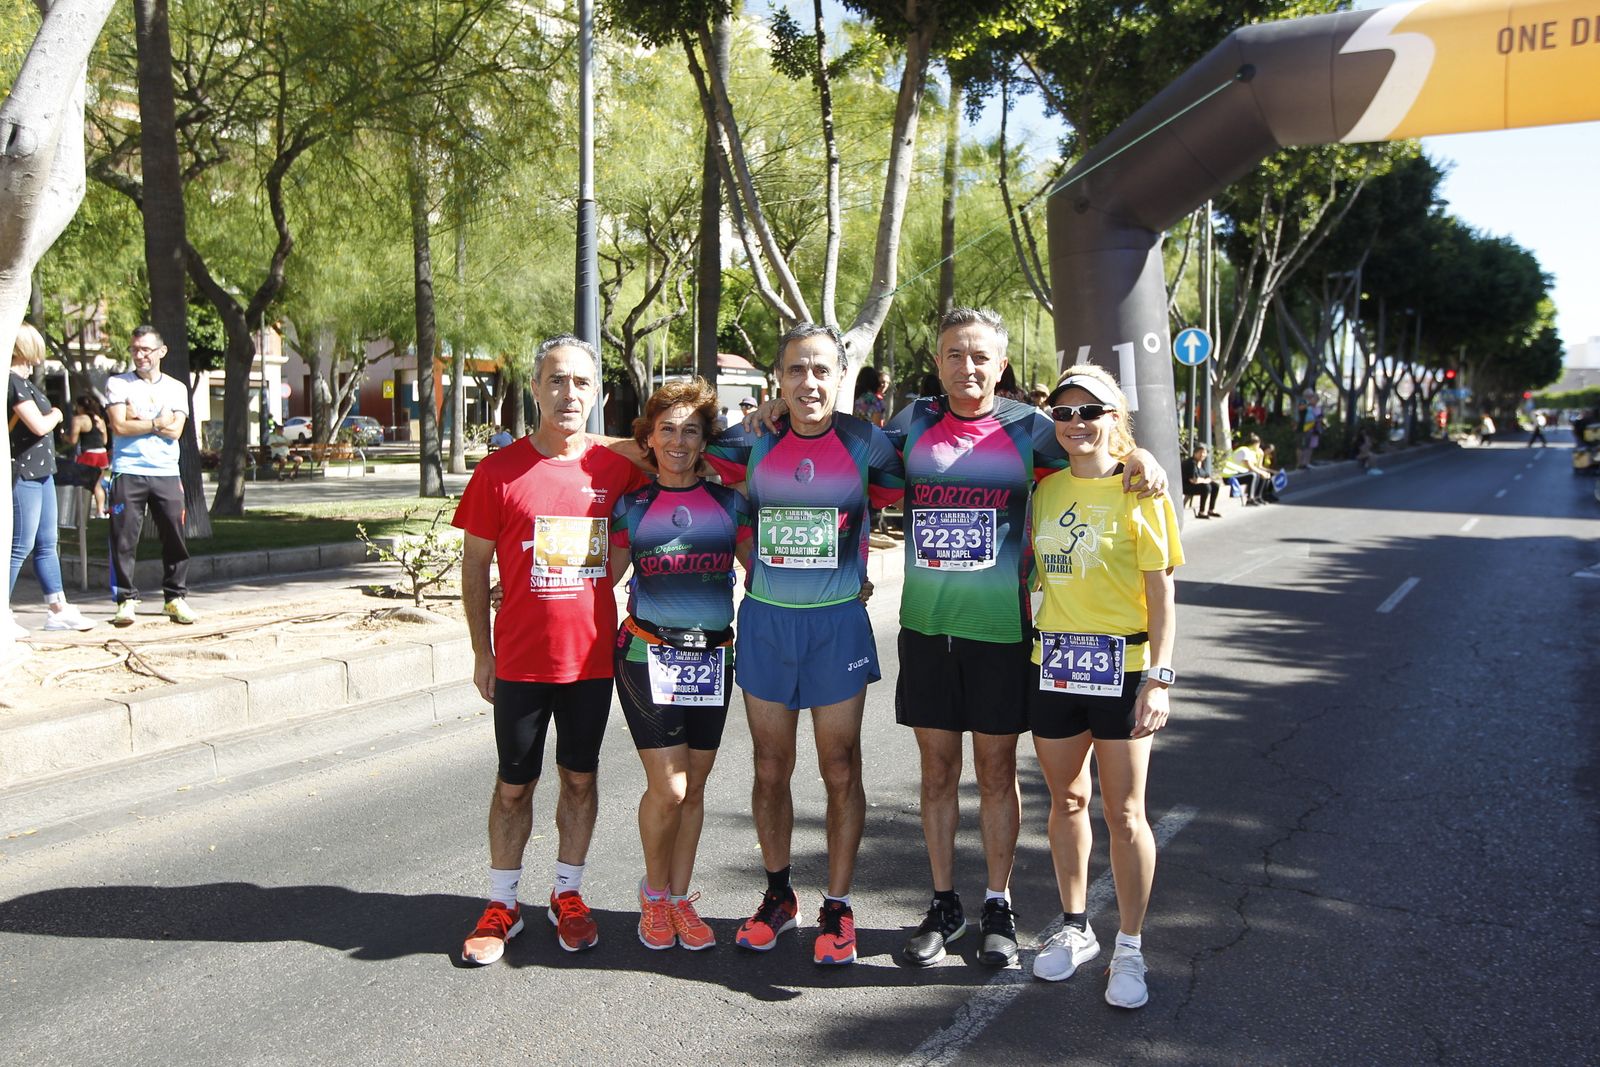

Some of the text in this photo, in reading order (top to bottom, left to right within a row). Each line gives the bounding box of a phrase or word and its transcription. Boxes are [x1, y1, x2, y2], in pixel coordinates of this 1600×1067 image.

[1498, 21, 1558, 55] ONE
[912, 484, 1010, 510] SPORTGYM
[767, 526, 823, 545] 1253
[921, 528, 982, 548] 2233
[790, 547, 820, 555] MARTINEZ
[936, 550, 971, 558] JUAN CAPEL
[640, 553, 732, 576] SPORTGYM
[1048, 649, 1109, 672] 2143
[655, 665, 710, 684] 232
[1072, 672, 1090, 681] ROCIO
